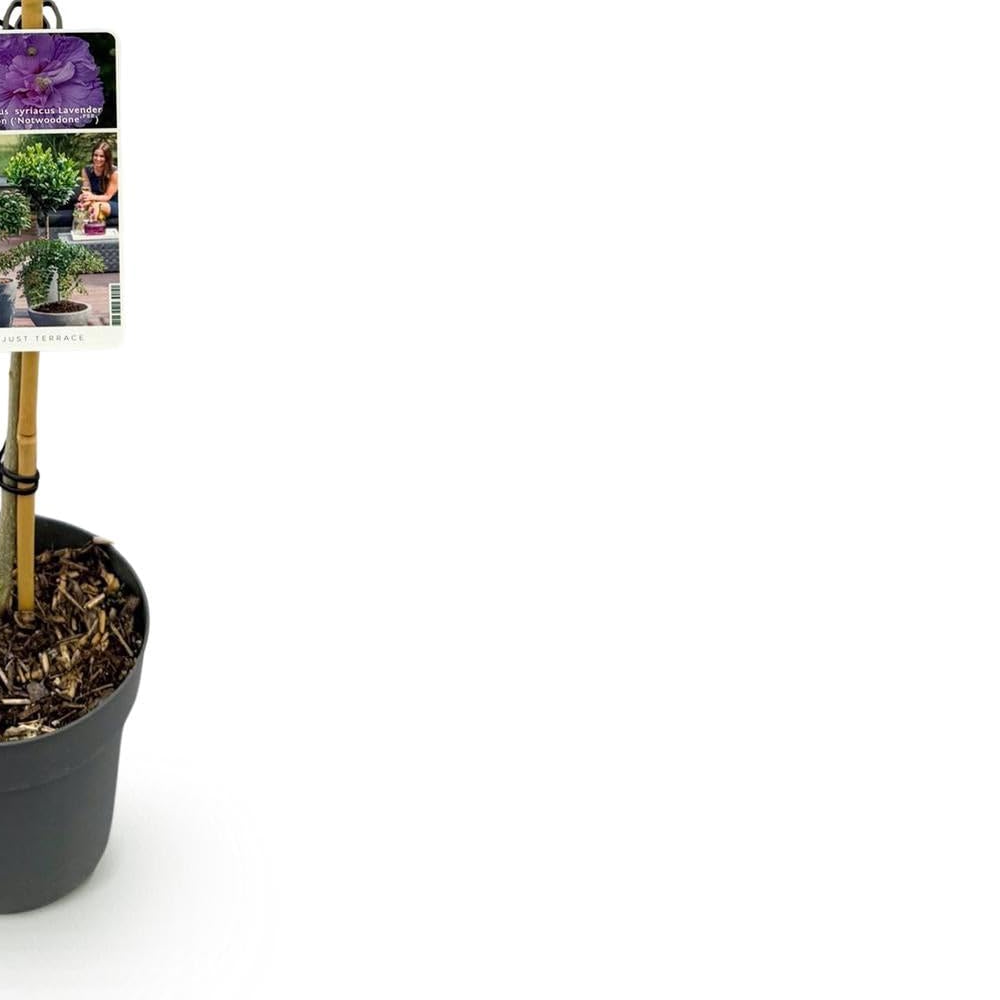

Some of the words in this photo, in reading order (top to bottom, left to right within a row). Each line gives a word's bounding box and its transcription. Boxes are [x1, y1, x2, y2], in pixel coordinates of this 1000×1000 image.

[14, 107, 55, 116] syriacus
[58, 106, 102, 114] Lavender
[1, 335, 28, 343] JUST
[35, 334, 85, 342] TERRACE
